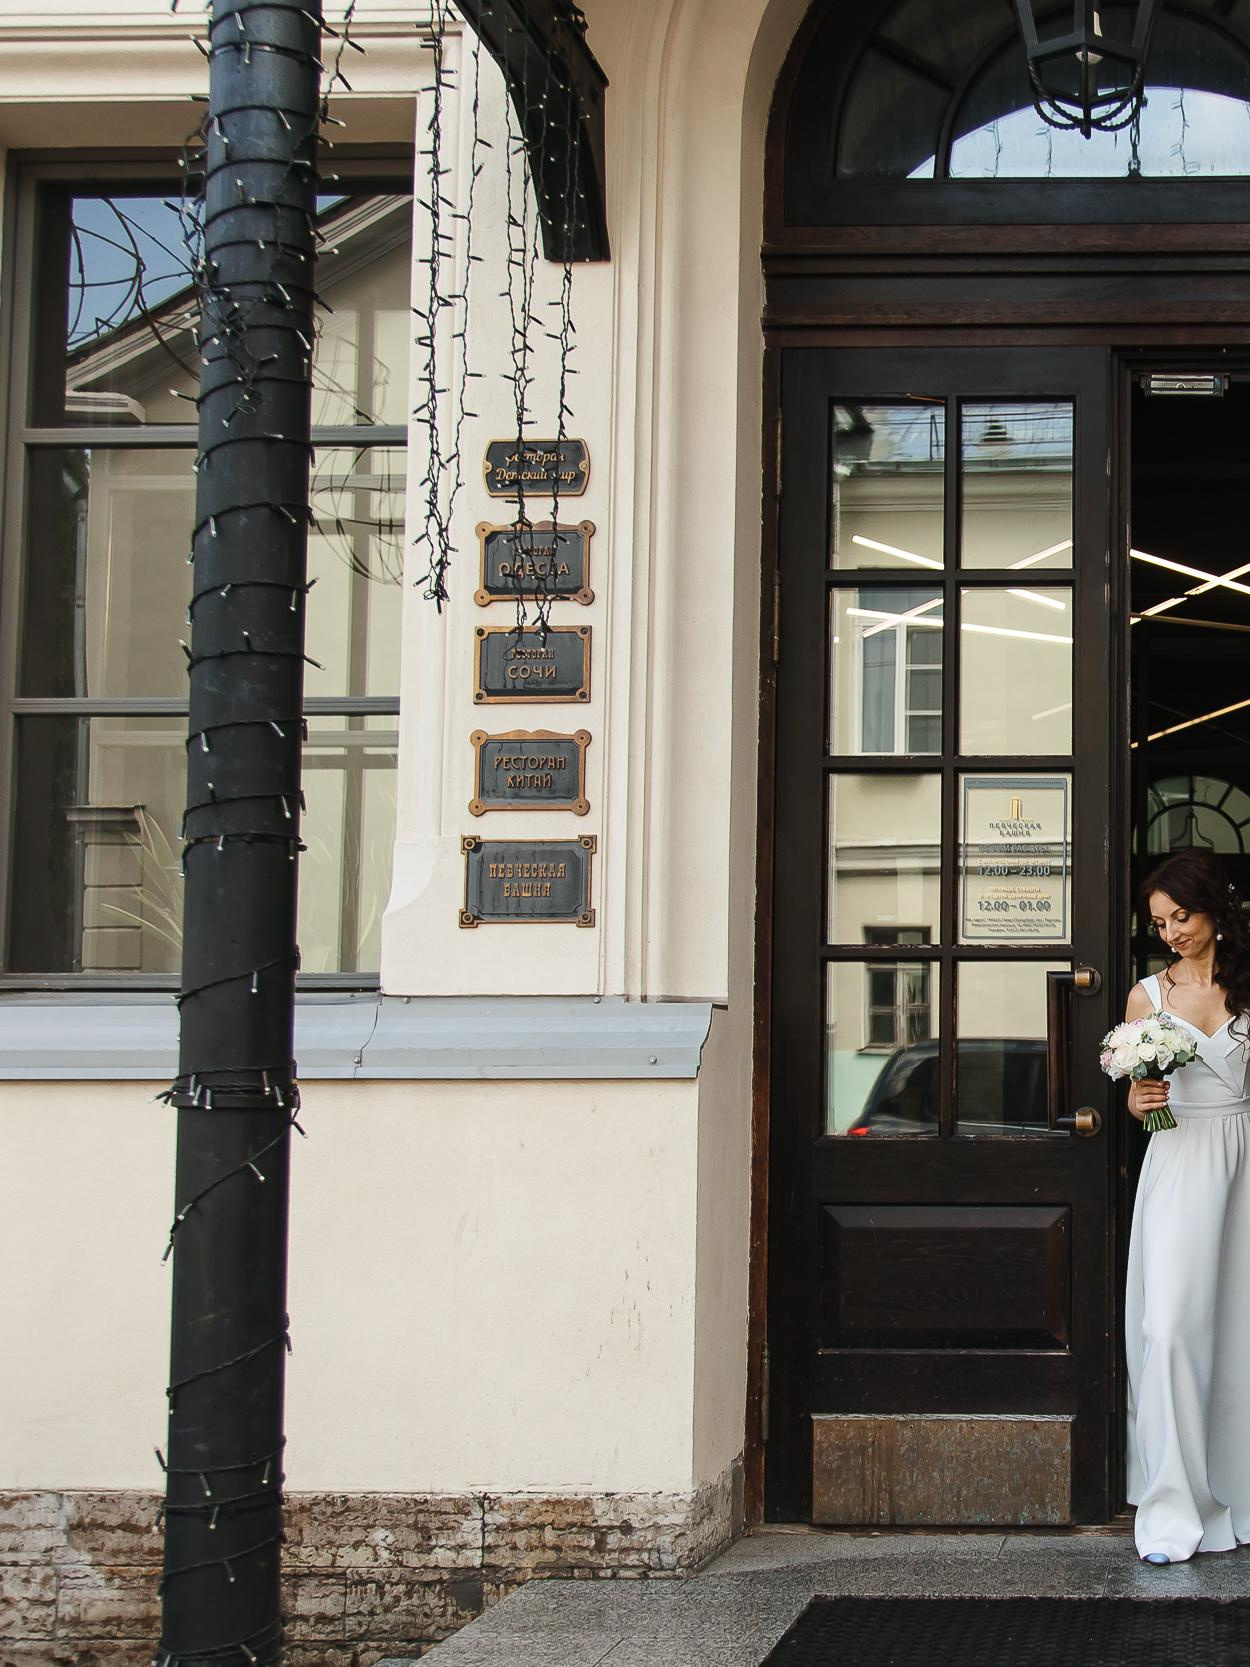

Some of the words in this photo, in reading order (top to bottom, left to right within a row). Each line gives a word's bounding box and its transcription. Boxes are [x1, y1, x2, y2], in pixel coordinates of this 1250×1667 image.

[507, 665, 557, 679] СОЧИ
[494, 755, 567, 770] РЕСТОРАН
[507, 773, 552, 789] КИТАЙ
[989, 822, 1042, 831] ПЕВЧЕСКАЯ
[489, 863, 567, 879] ПЕВЧЕСКАЯ
[979, 865, 1008, 877] 12.00
[1019, 865, 1052, 877] 23.00
[503, 881, 552, 898] БАШНЯ
[977, 900, 1009, 913] 12.00
[1018, 900, 1052, 913] 01.00
